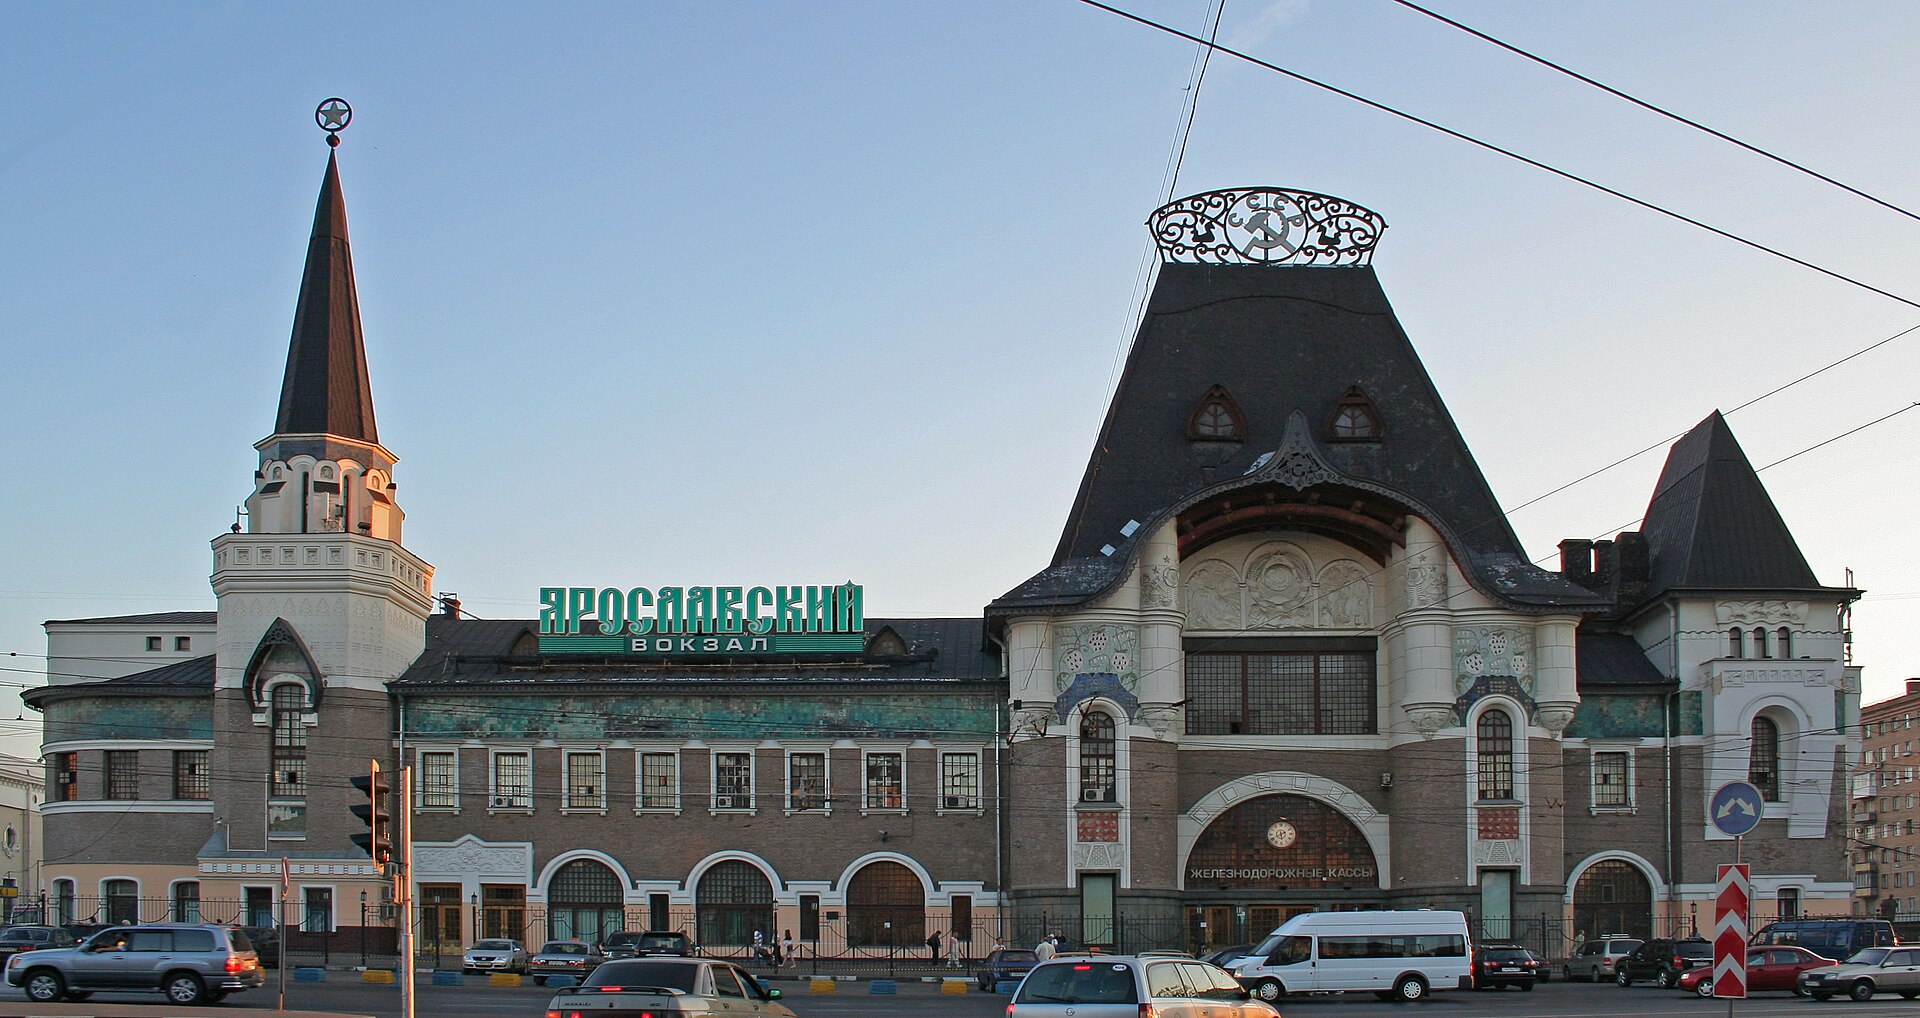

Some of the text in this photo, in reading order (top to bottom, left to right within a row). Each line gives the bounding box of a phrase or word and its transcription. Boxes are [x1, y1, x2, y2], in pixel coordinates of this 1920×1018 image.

[538, 580, 864, 635] ЯРОСЛАВСКИЙ
[631, 637, 768, 653] ВОКЗАЛ
[1190, 868, 1373, 880] ЖЕЛЕЗНОДОРОЖНЫЕ КАССЫ
